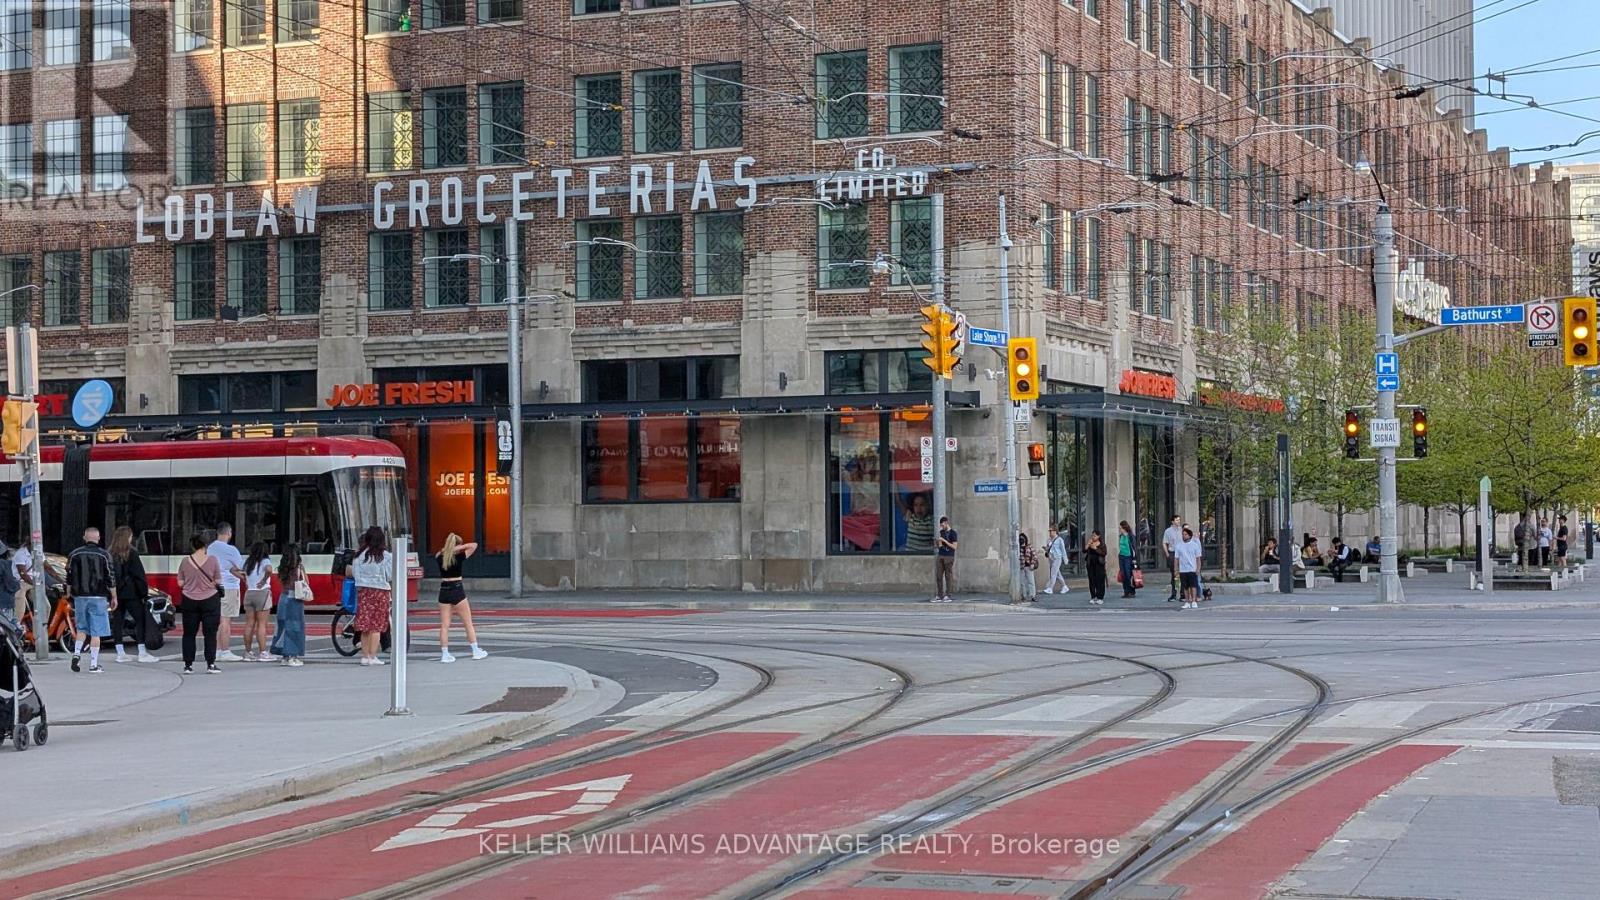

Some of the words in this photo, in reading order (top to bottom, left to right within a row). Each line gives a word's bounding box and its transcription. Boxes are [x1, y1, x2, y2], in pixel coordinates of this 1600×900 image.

[820, 171, 924, 200] LIMITED
[137, 186, 317, 243] LOBLAW
[374, 156, 757, 229] GROCETERIAS
[1452, 308, 1503, 321] Bathurst
[972, 330, 983, 342] Lake
[984, 331, 997, 343] Shore
[1379, 356, 1395, 373] H
[325, 384, 379, 408] JOE
[385, 381, 475, 406] FRESH
[1373, 422, 1398, 432] TRANSIT
[1375, 434, 1396, 443] SIGNAL
[436, 473, 465, 486] JOE
